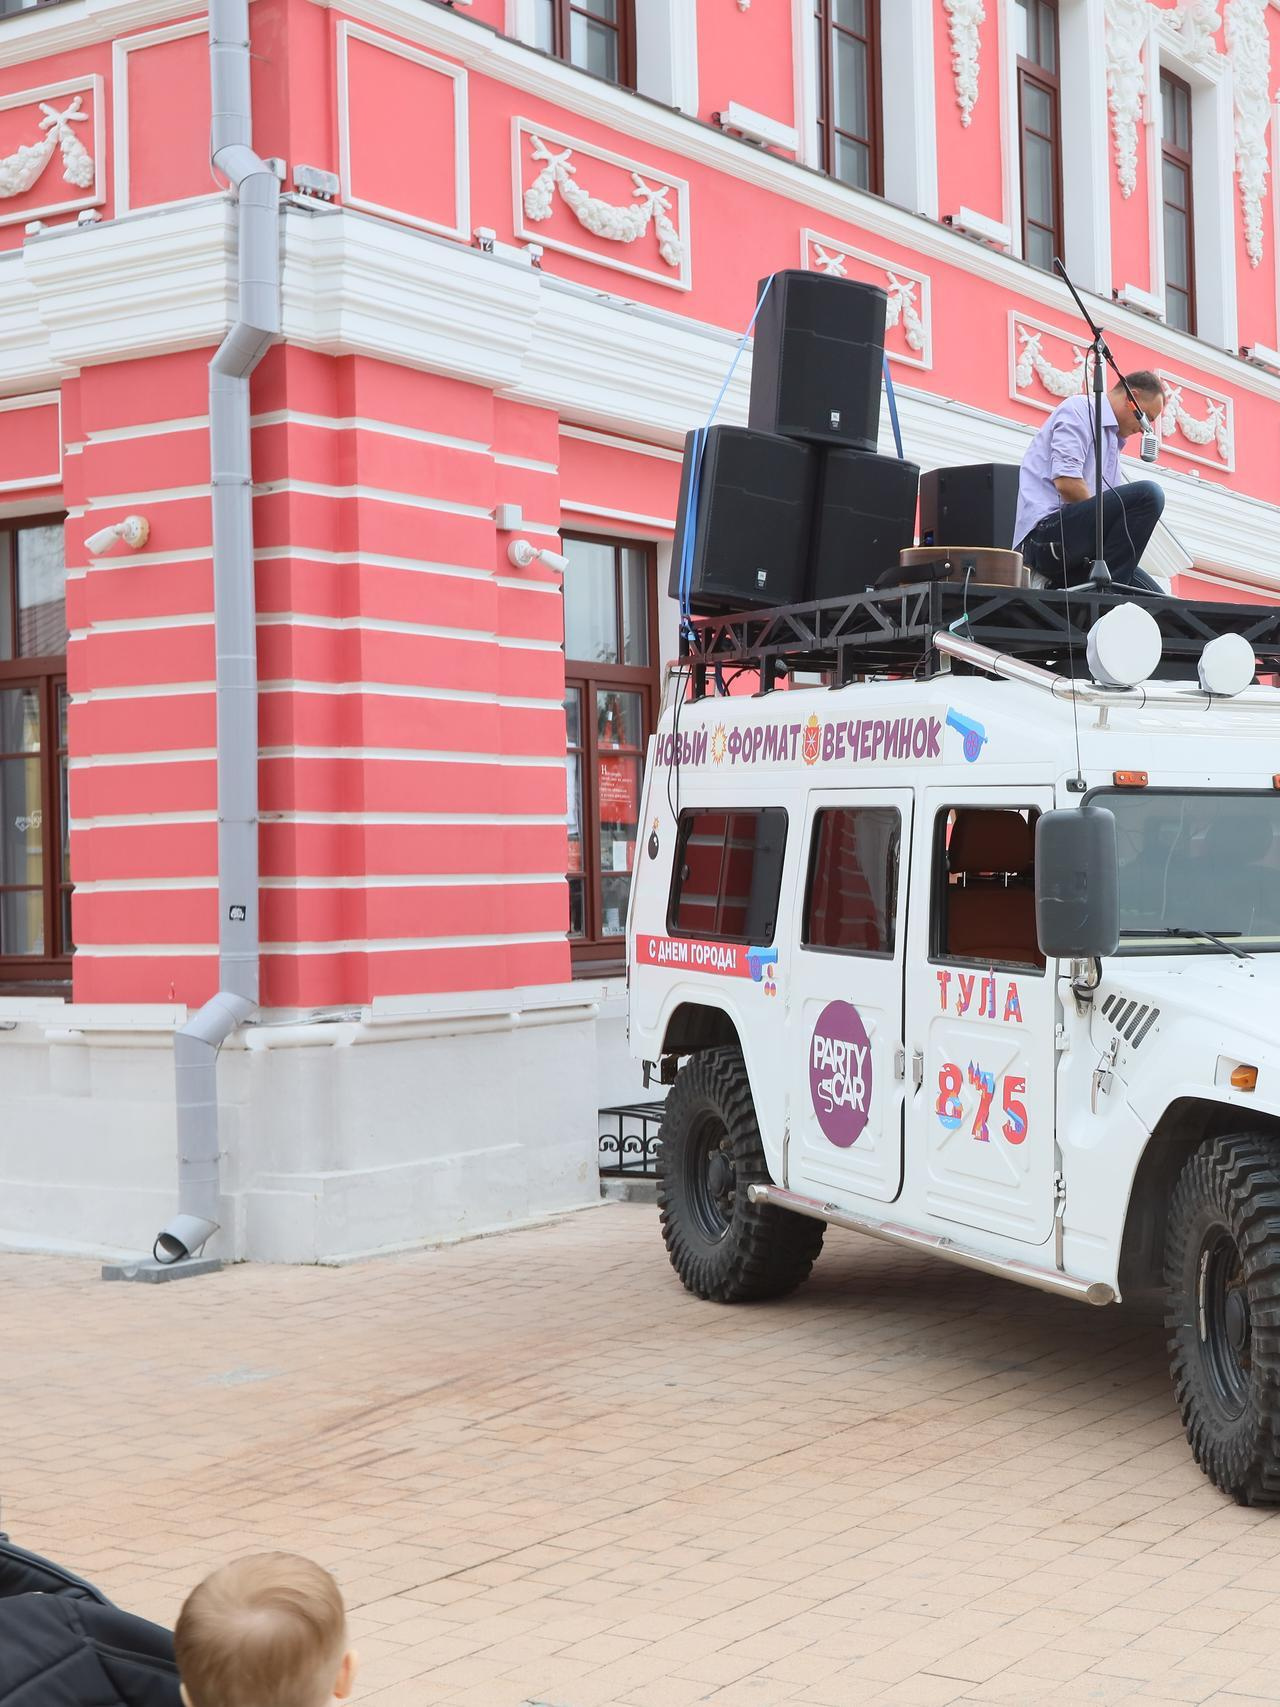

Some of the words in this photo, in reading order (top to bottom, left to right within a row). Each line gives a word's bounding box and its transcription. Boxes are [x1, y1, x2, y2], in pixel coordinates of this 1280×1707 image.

[655, 722, 708, 768] НОВЫЙ
[727, 724, 801, 765] ФОРМАТ
[822, 716, 942, 762] ВЕЧЕРИНОК
[649, 939, 656, 958] С
[658, 941, 688, 963] ДНЕМ
[690, 944, 737, 971] ГОРОДА!
[937, 967, 1023, 1022] ТУЛА
[813, 1034, 868, 1079] PARTY
[832, 1072, 865, 1113] CAR
[936, 1059, 1028, 1145] 875
